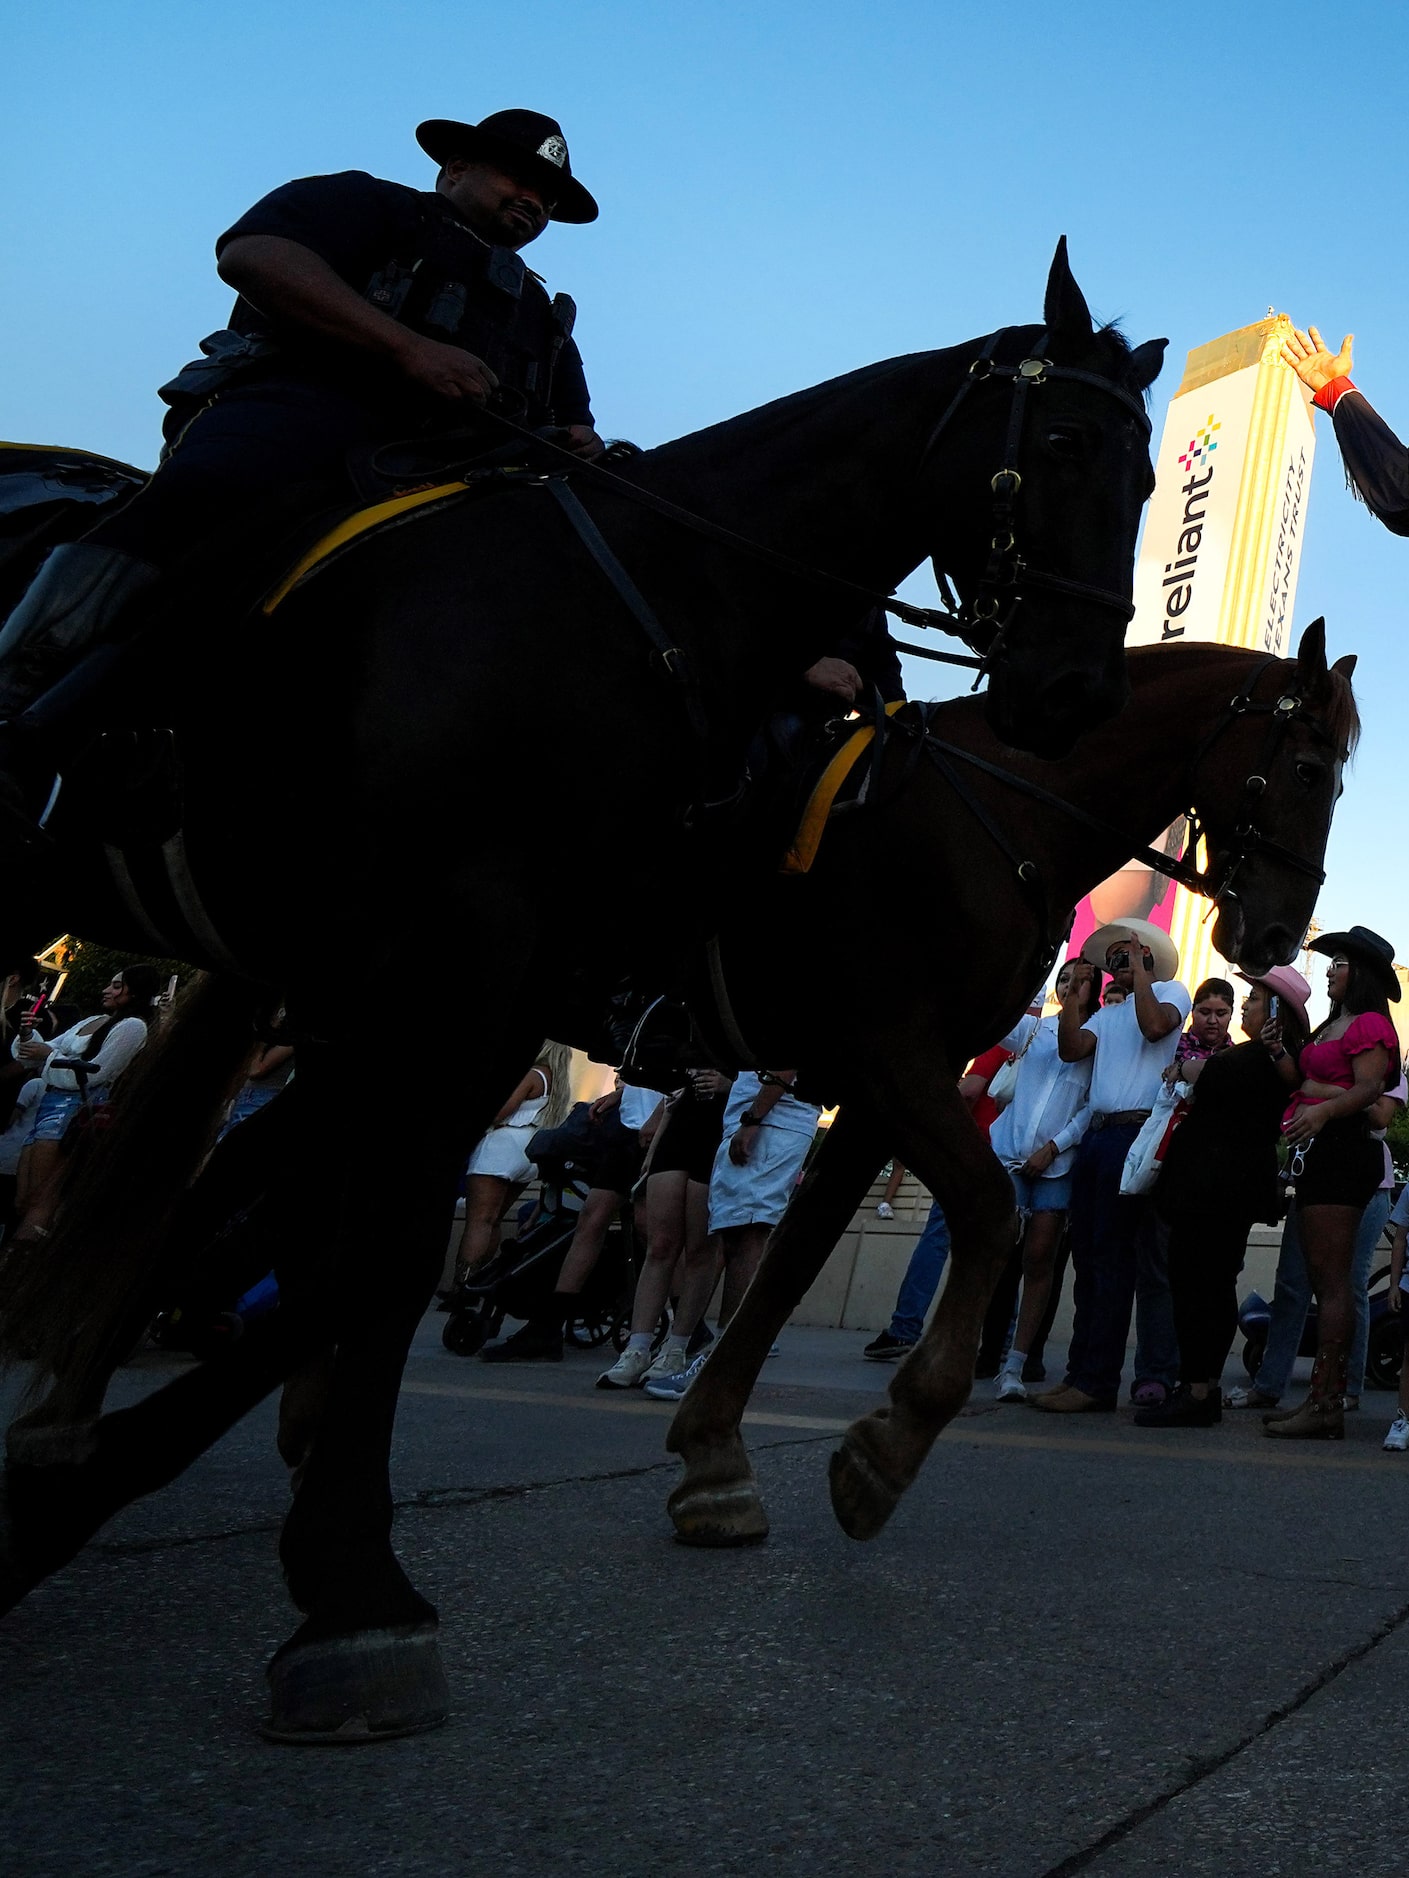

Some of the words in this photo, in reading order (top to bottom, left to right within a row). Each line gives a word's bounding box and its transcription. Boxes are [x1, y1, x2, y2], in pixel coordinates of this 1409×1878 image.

[1161, 465, 1214, 641] reliant
[1264, 455, 1295, 651] ELECTRICITY
[1290, 446, 1306, 539] TRUST
